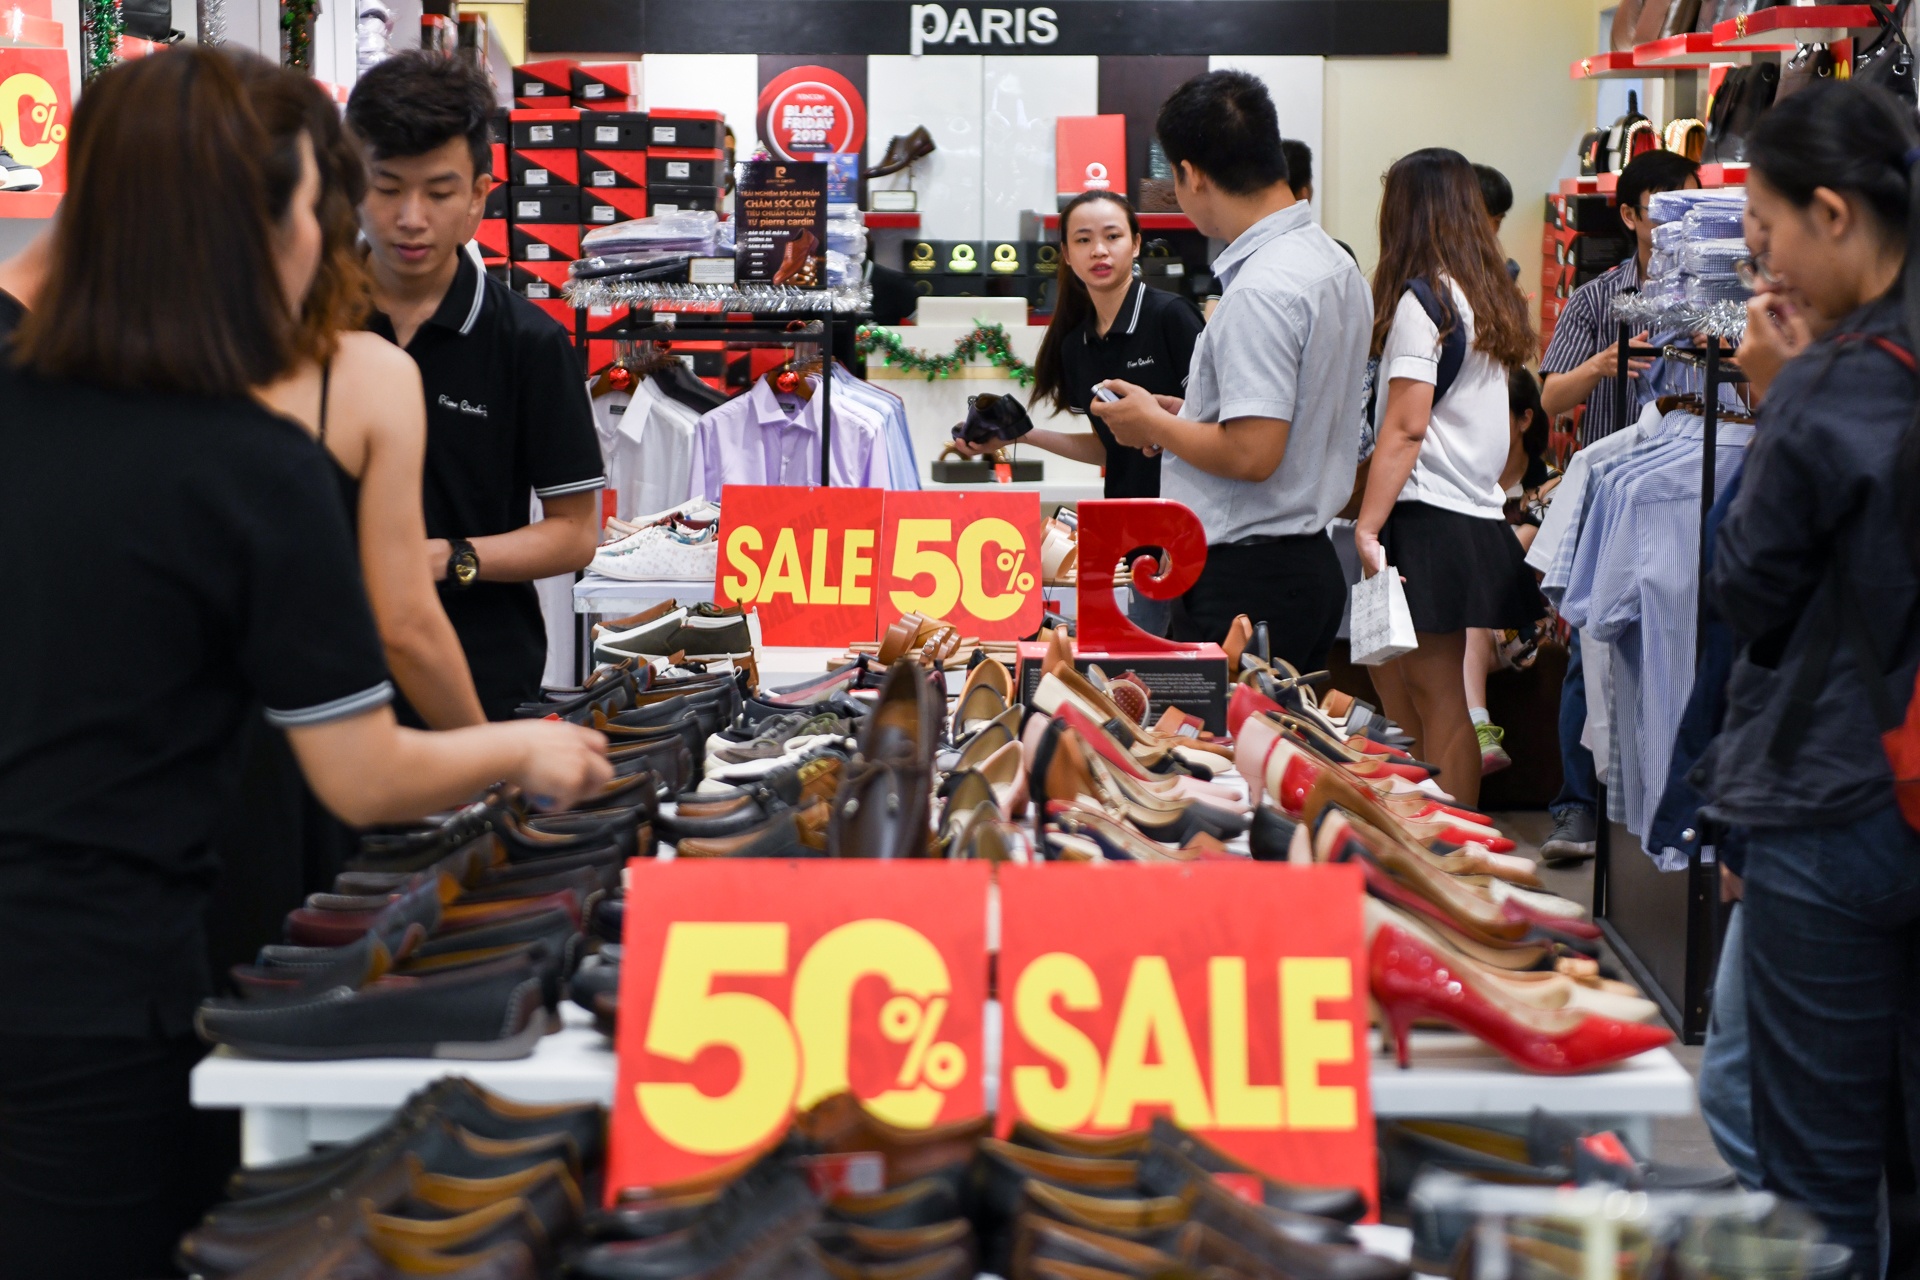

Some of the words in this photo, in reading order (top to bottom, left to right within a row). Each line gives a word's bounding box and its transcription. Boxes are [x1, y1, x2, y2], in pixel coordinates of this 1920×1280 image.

[783, 105, 834, 117] BLACK
[782, 117, 835, 130] FRIDAY
[791, 129, 827, 142] 2019
[760, 217, 785, 228] pierre
[787, 217, 815, 226] cardin
[722, 525, 875, 605] SALE
[888, 517, 1035, 621] 50%
[634, 918, 968, 1156] 50%
[1011, 952, 1359, 1132] SALE
